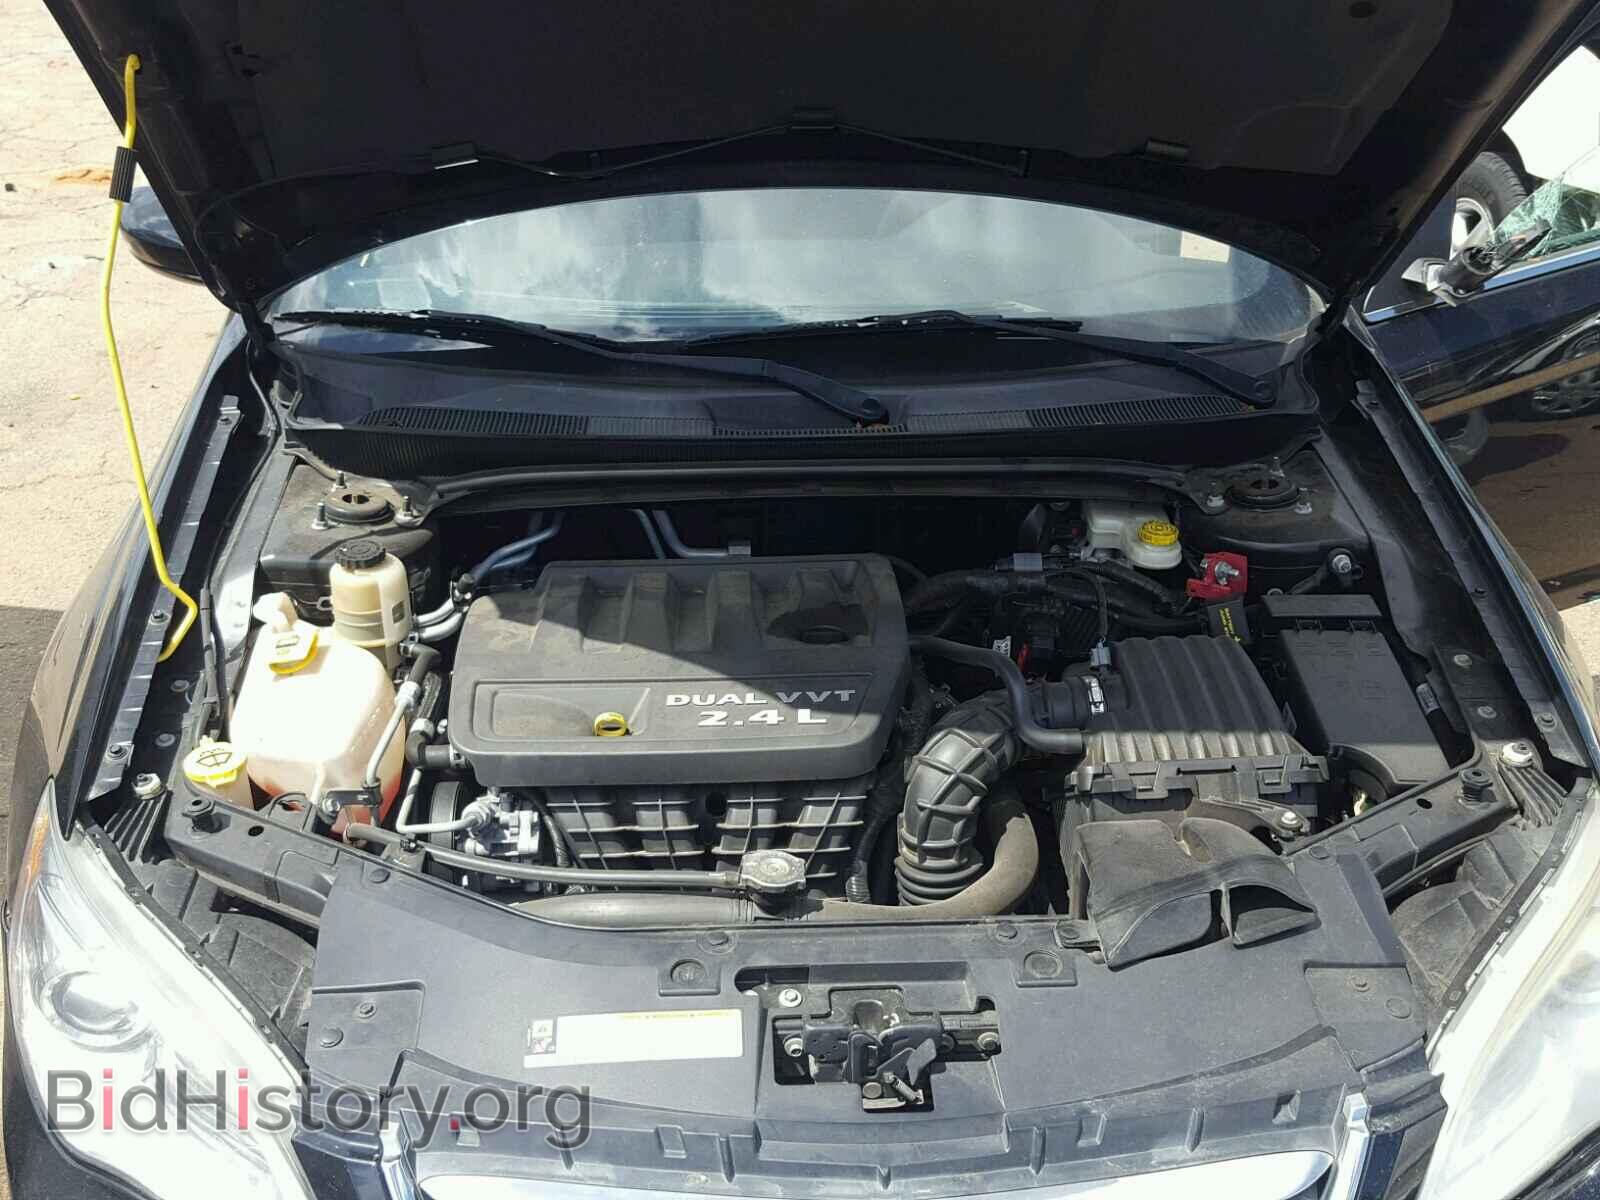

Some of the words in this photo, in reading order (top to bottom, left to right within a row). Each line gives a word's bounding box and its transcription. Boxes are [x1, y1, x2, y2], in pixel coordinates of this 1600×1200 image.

[665, 693, 768, 706] DUAL
[776, 689, 856, 704] VVT
[697, 709, 785, 726] 2.4
[796, 708, 828, 725] L
